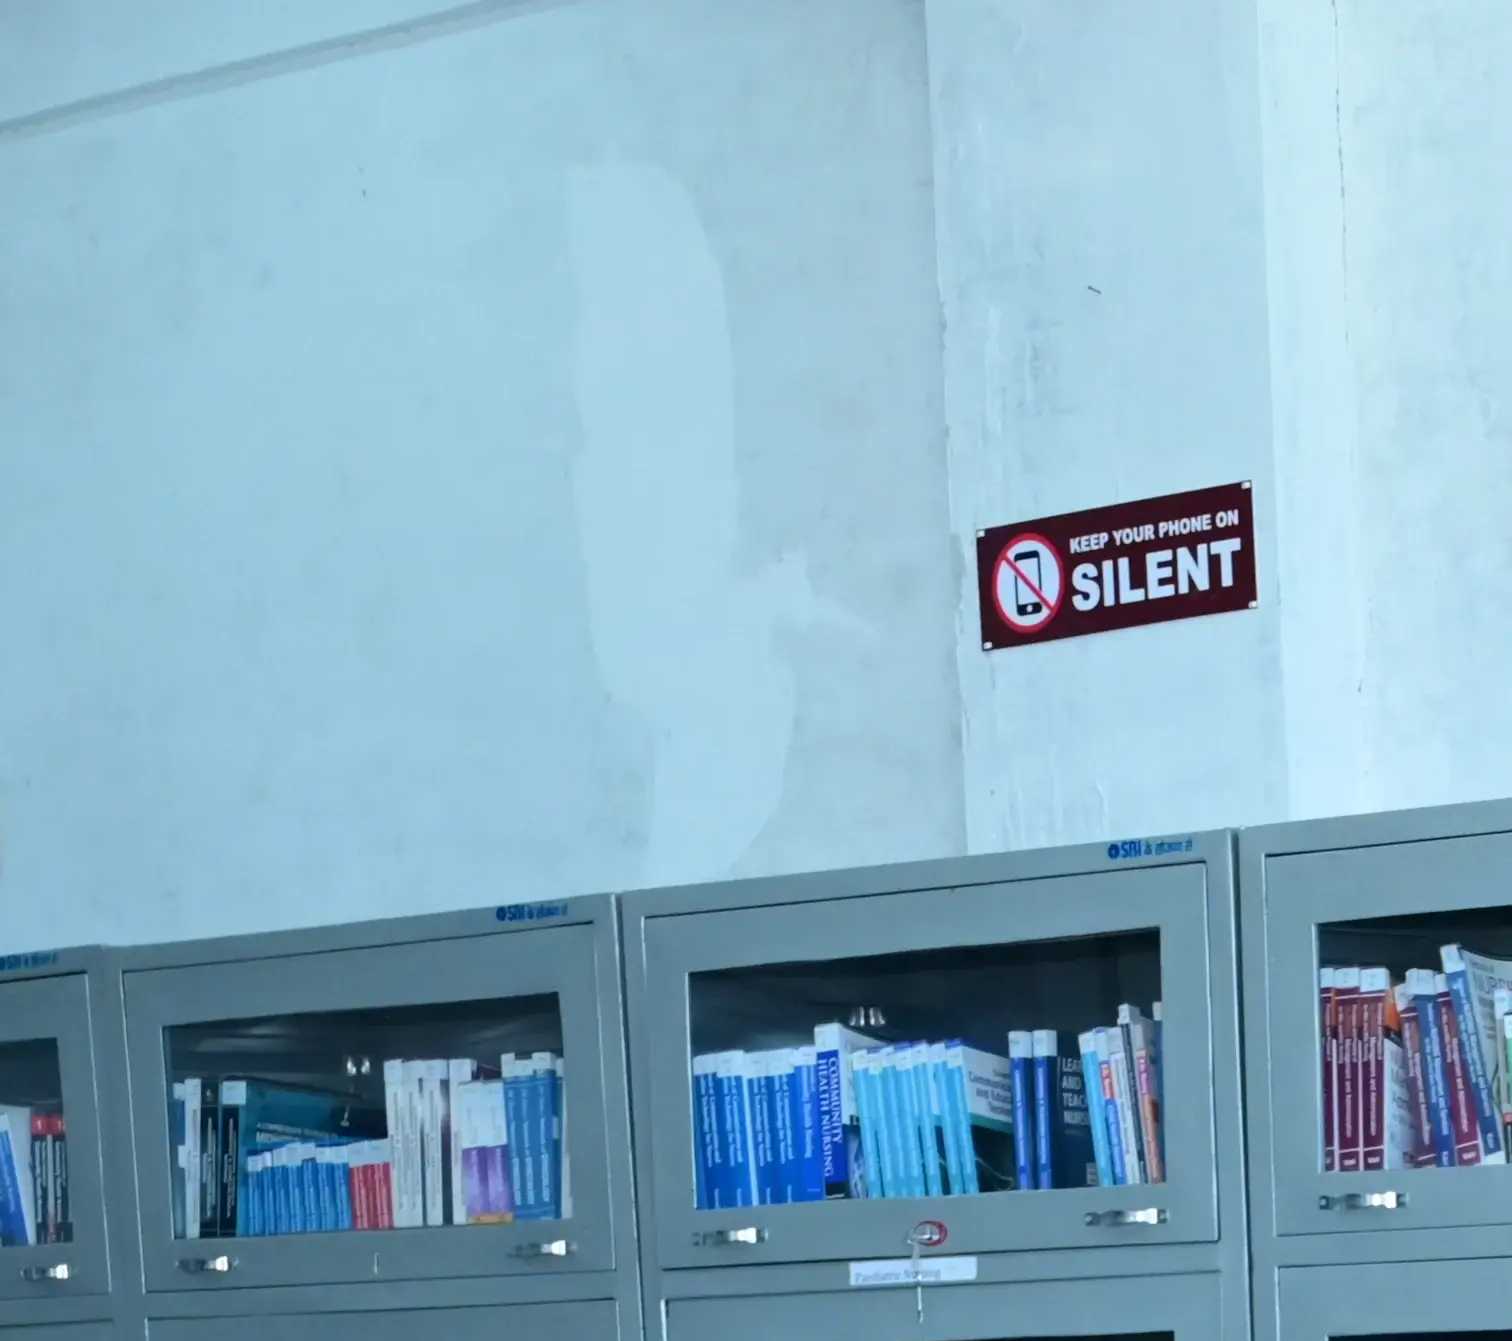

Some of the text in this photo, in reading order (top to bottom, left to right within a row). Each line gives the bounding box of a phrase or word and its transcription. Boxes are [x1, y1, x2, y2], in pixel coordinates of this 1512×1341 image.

[1069, 509, 1239, 554] KEEP YOUR PHONE ON
[1071, 537, 1241, 612] SILENT
[817, 1059, 834, 1177] HEALTH NURSING
[828, 1057, 843, 1144] COMMUNITY
